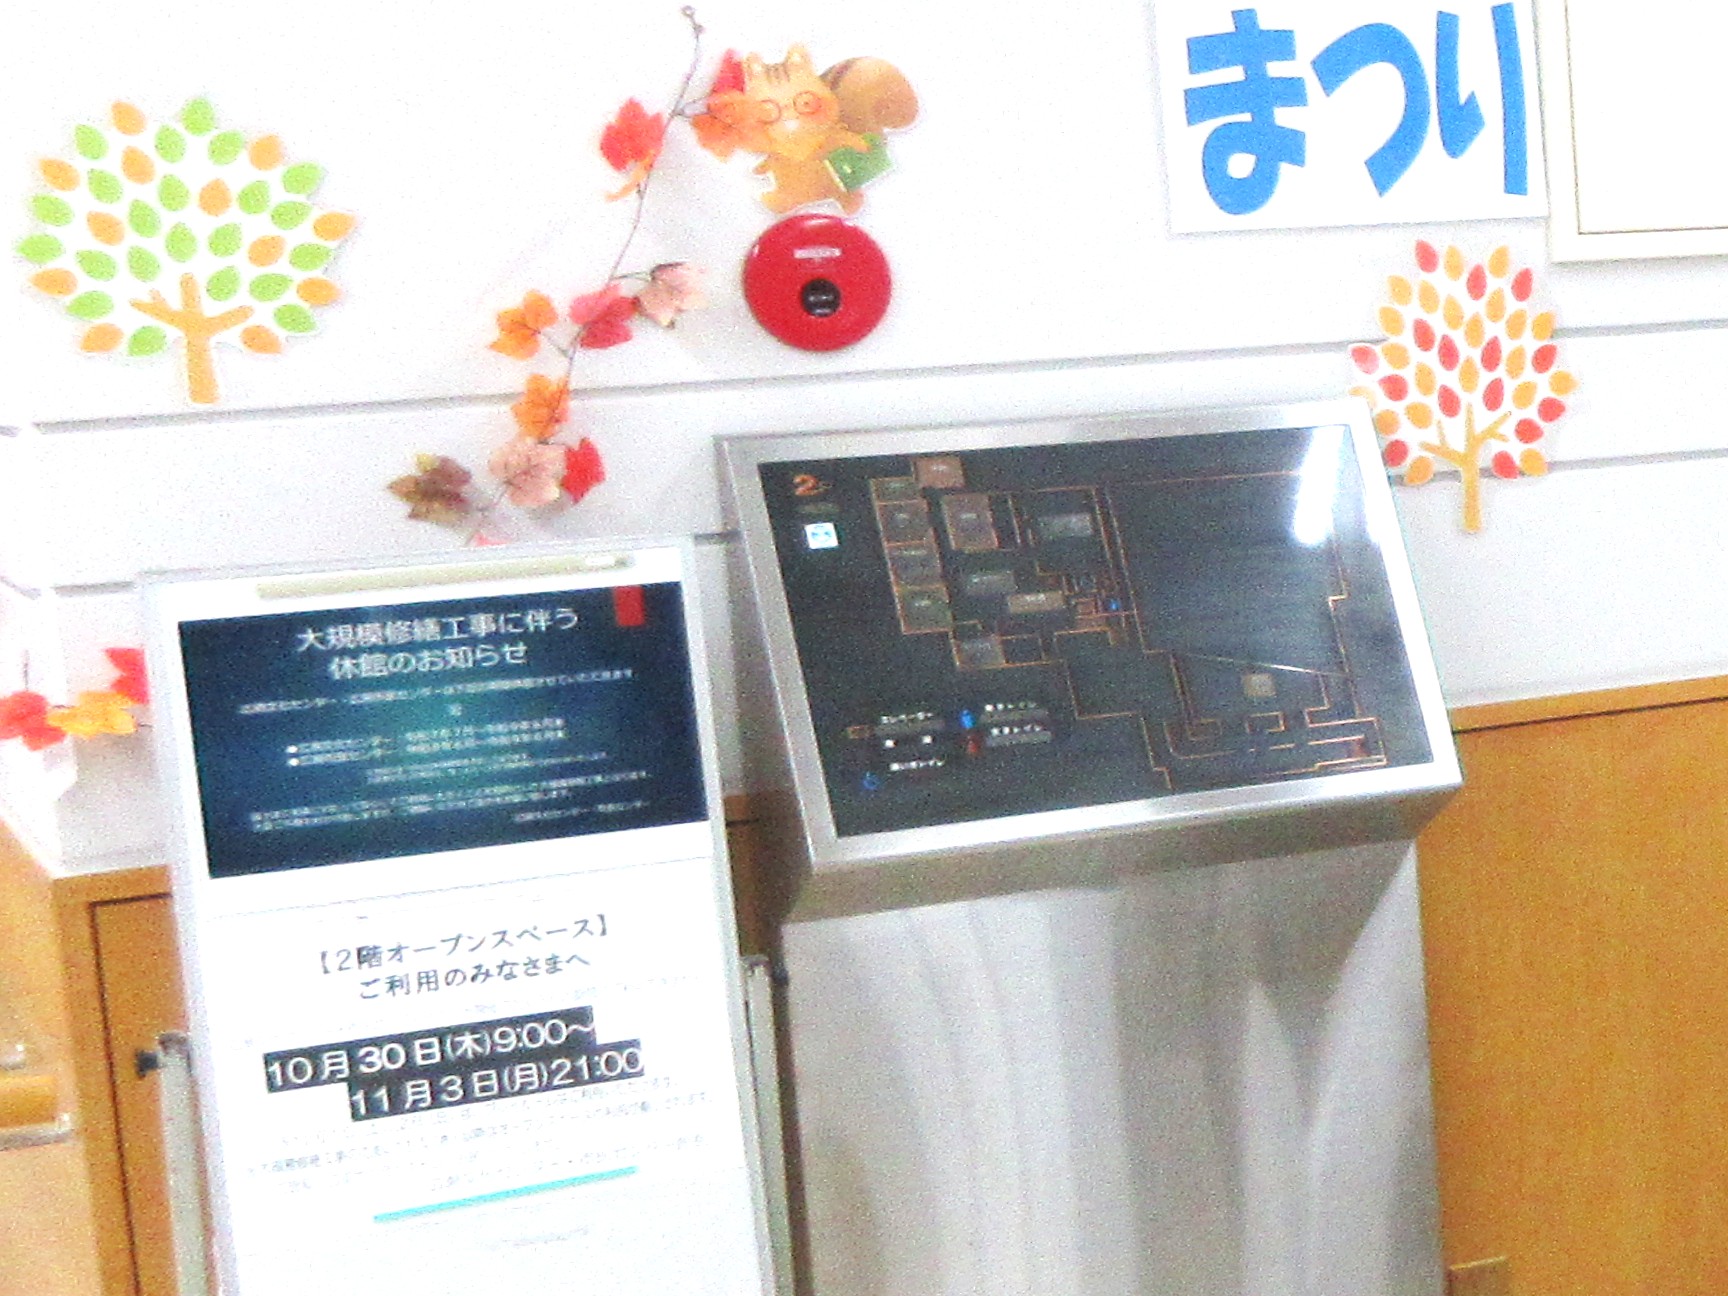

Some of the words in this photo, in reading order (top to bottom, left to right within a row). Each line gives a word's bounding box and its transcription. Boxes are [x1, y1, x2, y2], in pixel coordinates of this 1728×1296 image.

[1184, 2, 1528, 215] まつり
[298, 608, 578, 651] 大規模修繕工事に伴う
[330, 643, 528, 679] 休館のお知らせ
[359, 954, 592, 1000] ご利用のみなさまへ
